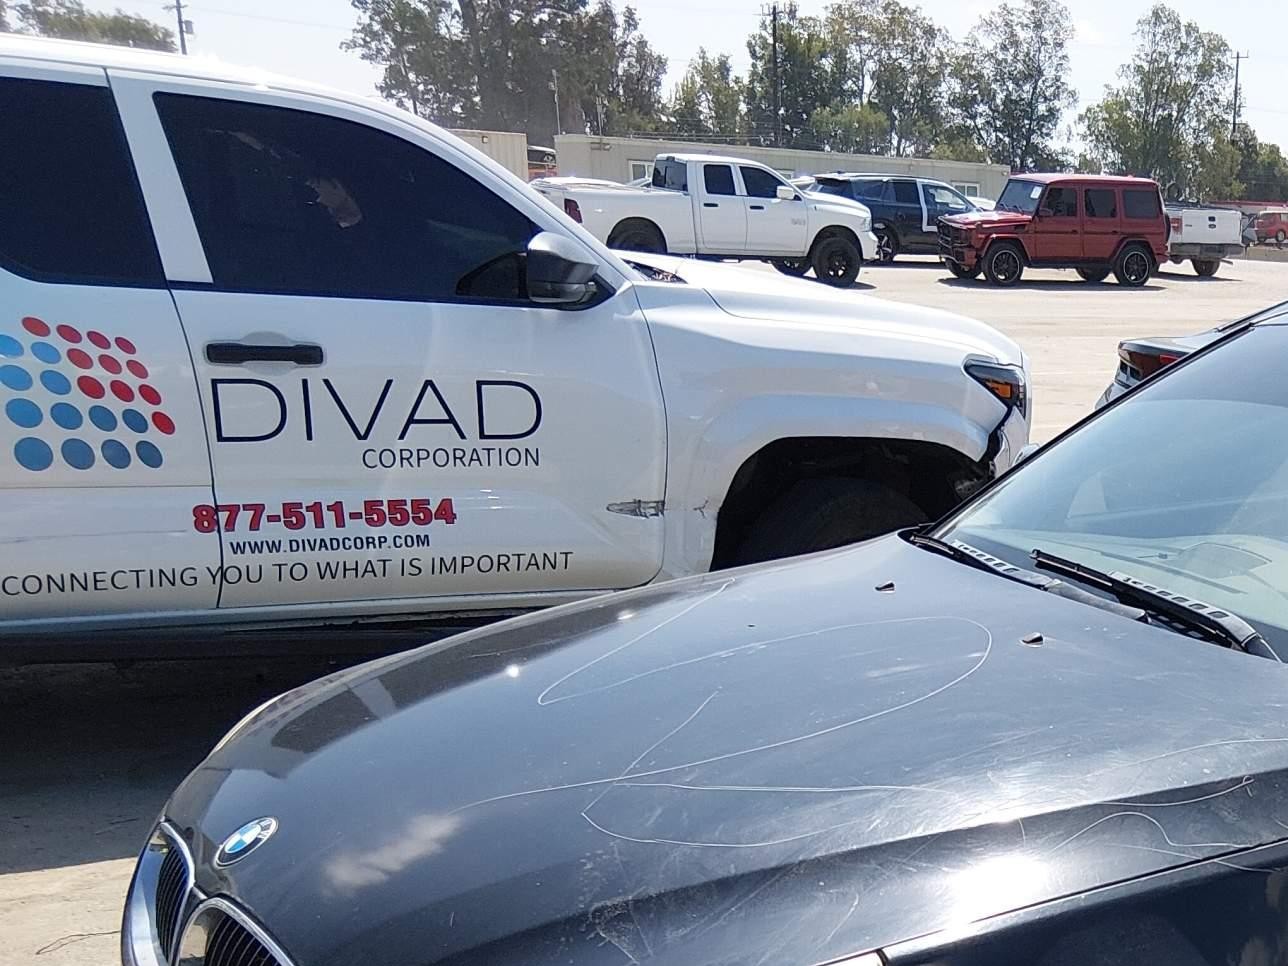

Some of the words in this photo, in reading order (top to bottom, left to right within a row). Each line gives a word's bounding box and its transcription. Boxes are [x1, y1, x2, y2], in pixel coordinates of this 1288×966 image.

[210, 377, 543, 443] DIVAD
[362, 447, 541, 469] CORPORATION
[192, 498, 458, 533] 877-511-5554
[229, 534, 431, 555] WWW.DIVADCORP.COM
[1, 566, 199, 596] CONNECTING
[206, 564, 264, 586] YOU
[271, 562, 308, 582] TO
[316, 559, 392, 580] WHAT
[400, 558, 423, 577] IS
[431, 551, 574, 576] IMPORTANT
